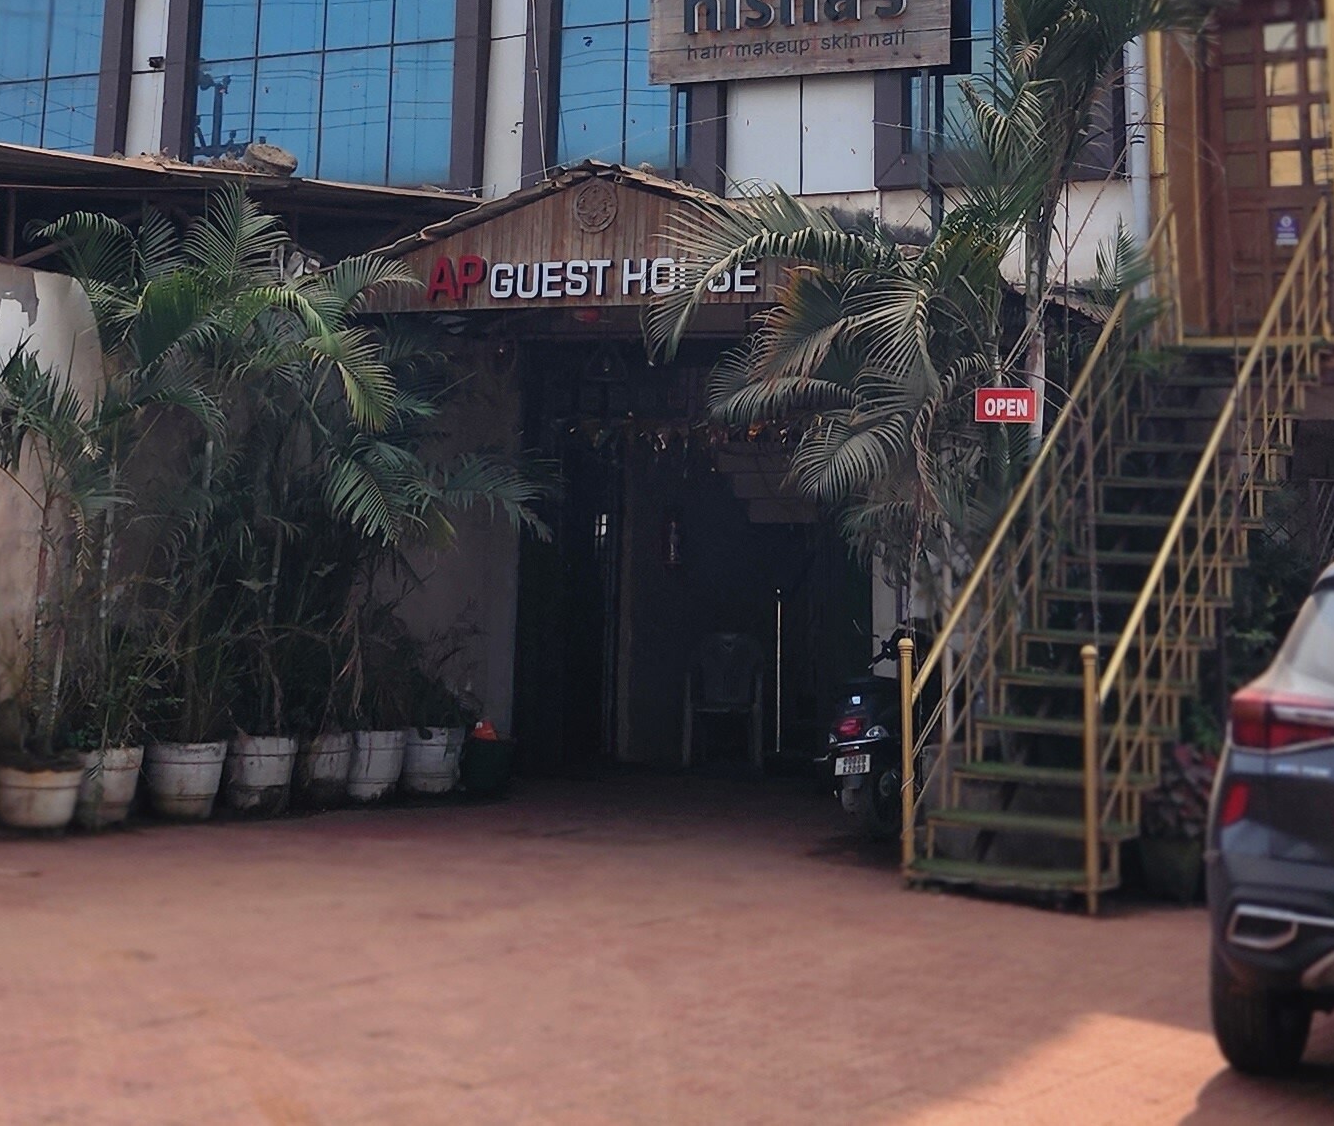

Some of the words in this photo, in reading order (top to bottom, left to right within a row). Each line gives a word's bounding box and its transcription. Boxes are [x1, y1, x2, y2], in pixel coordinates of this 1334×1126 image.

[687, 44, 725, 61] hair
[735, 39, 810, 58] makeup
[820, 33, 860, 51] skin
[868, 29, 906, 47] nail
[427, 254, 487, 300] AP
[490, 258, 612, 299] GUEST
[984, 398, 1028, 416] OPEN
